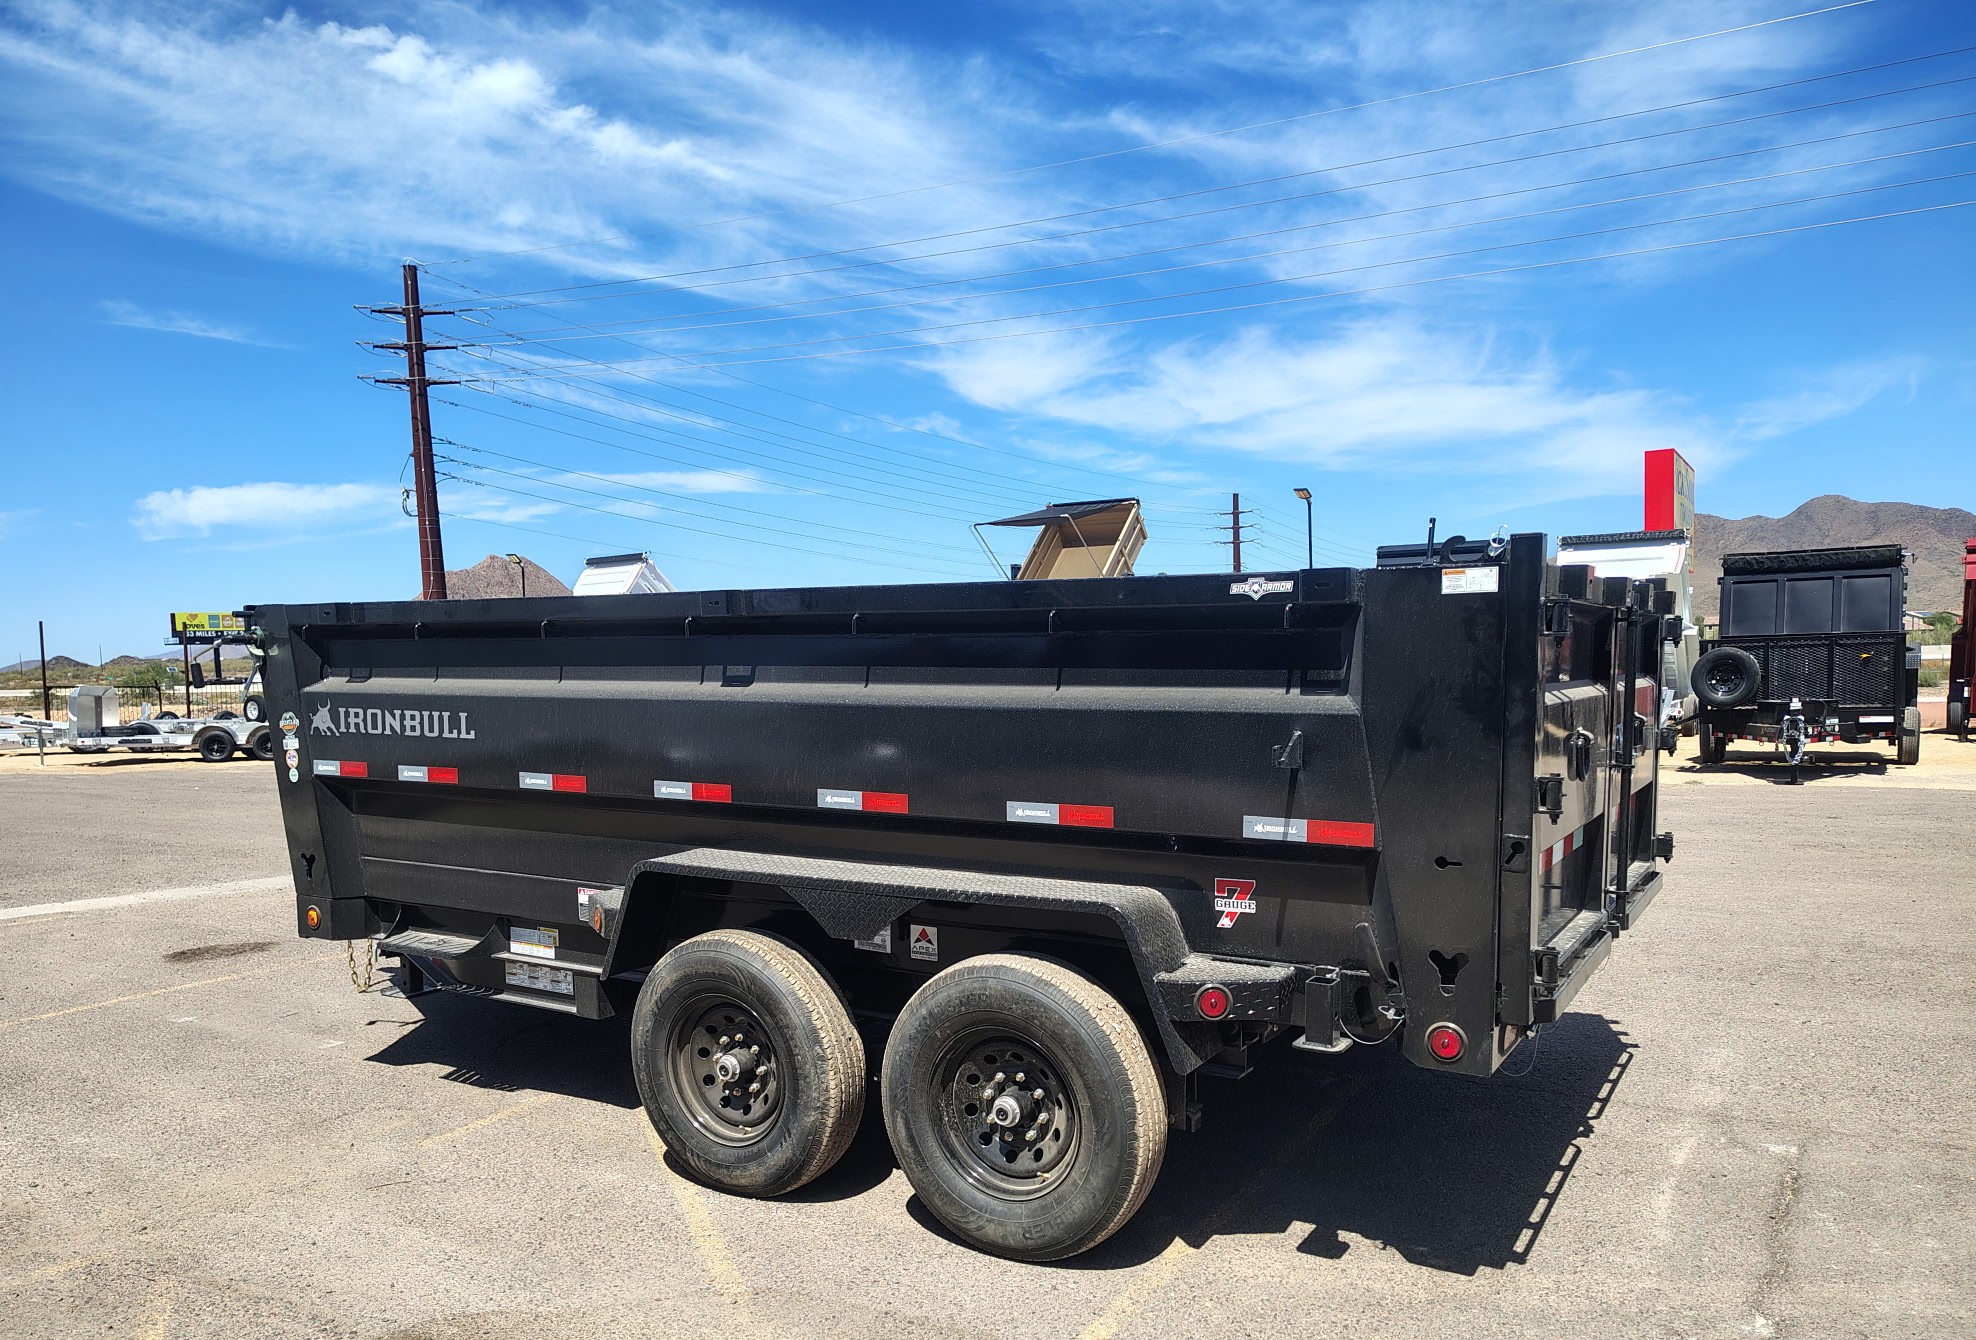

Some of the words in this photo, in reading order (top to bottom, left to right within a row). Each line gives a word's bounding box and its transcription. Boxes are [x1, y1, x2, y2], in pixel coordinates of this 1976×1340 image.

[1231, 584, 1251, 593] SIDE
[1261, 582, 1292, 592] ARMOR
[338, 707, 476, 739] IRONBULL
[1214, 877, 1256, 928] 7
[1215, 899, 1255, 911] GAUGE
[911, 945, 937, 953] APEX
